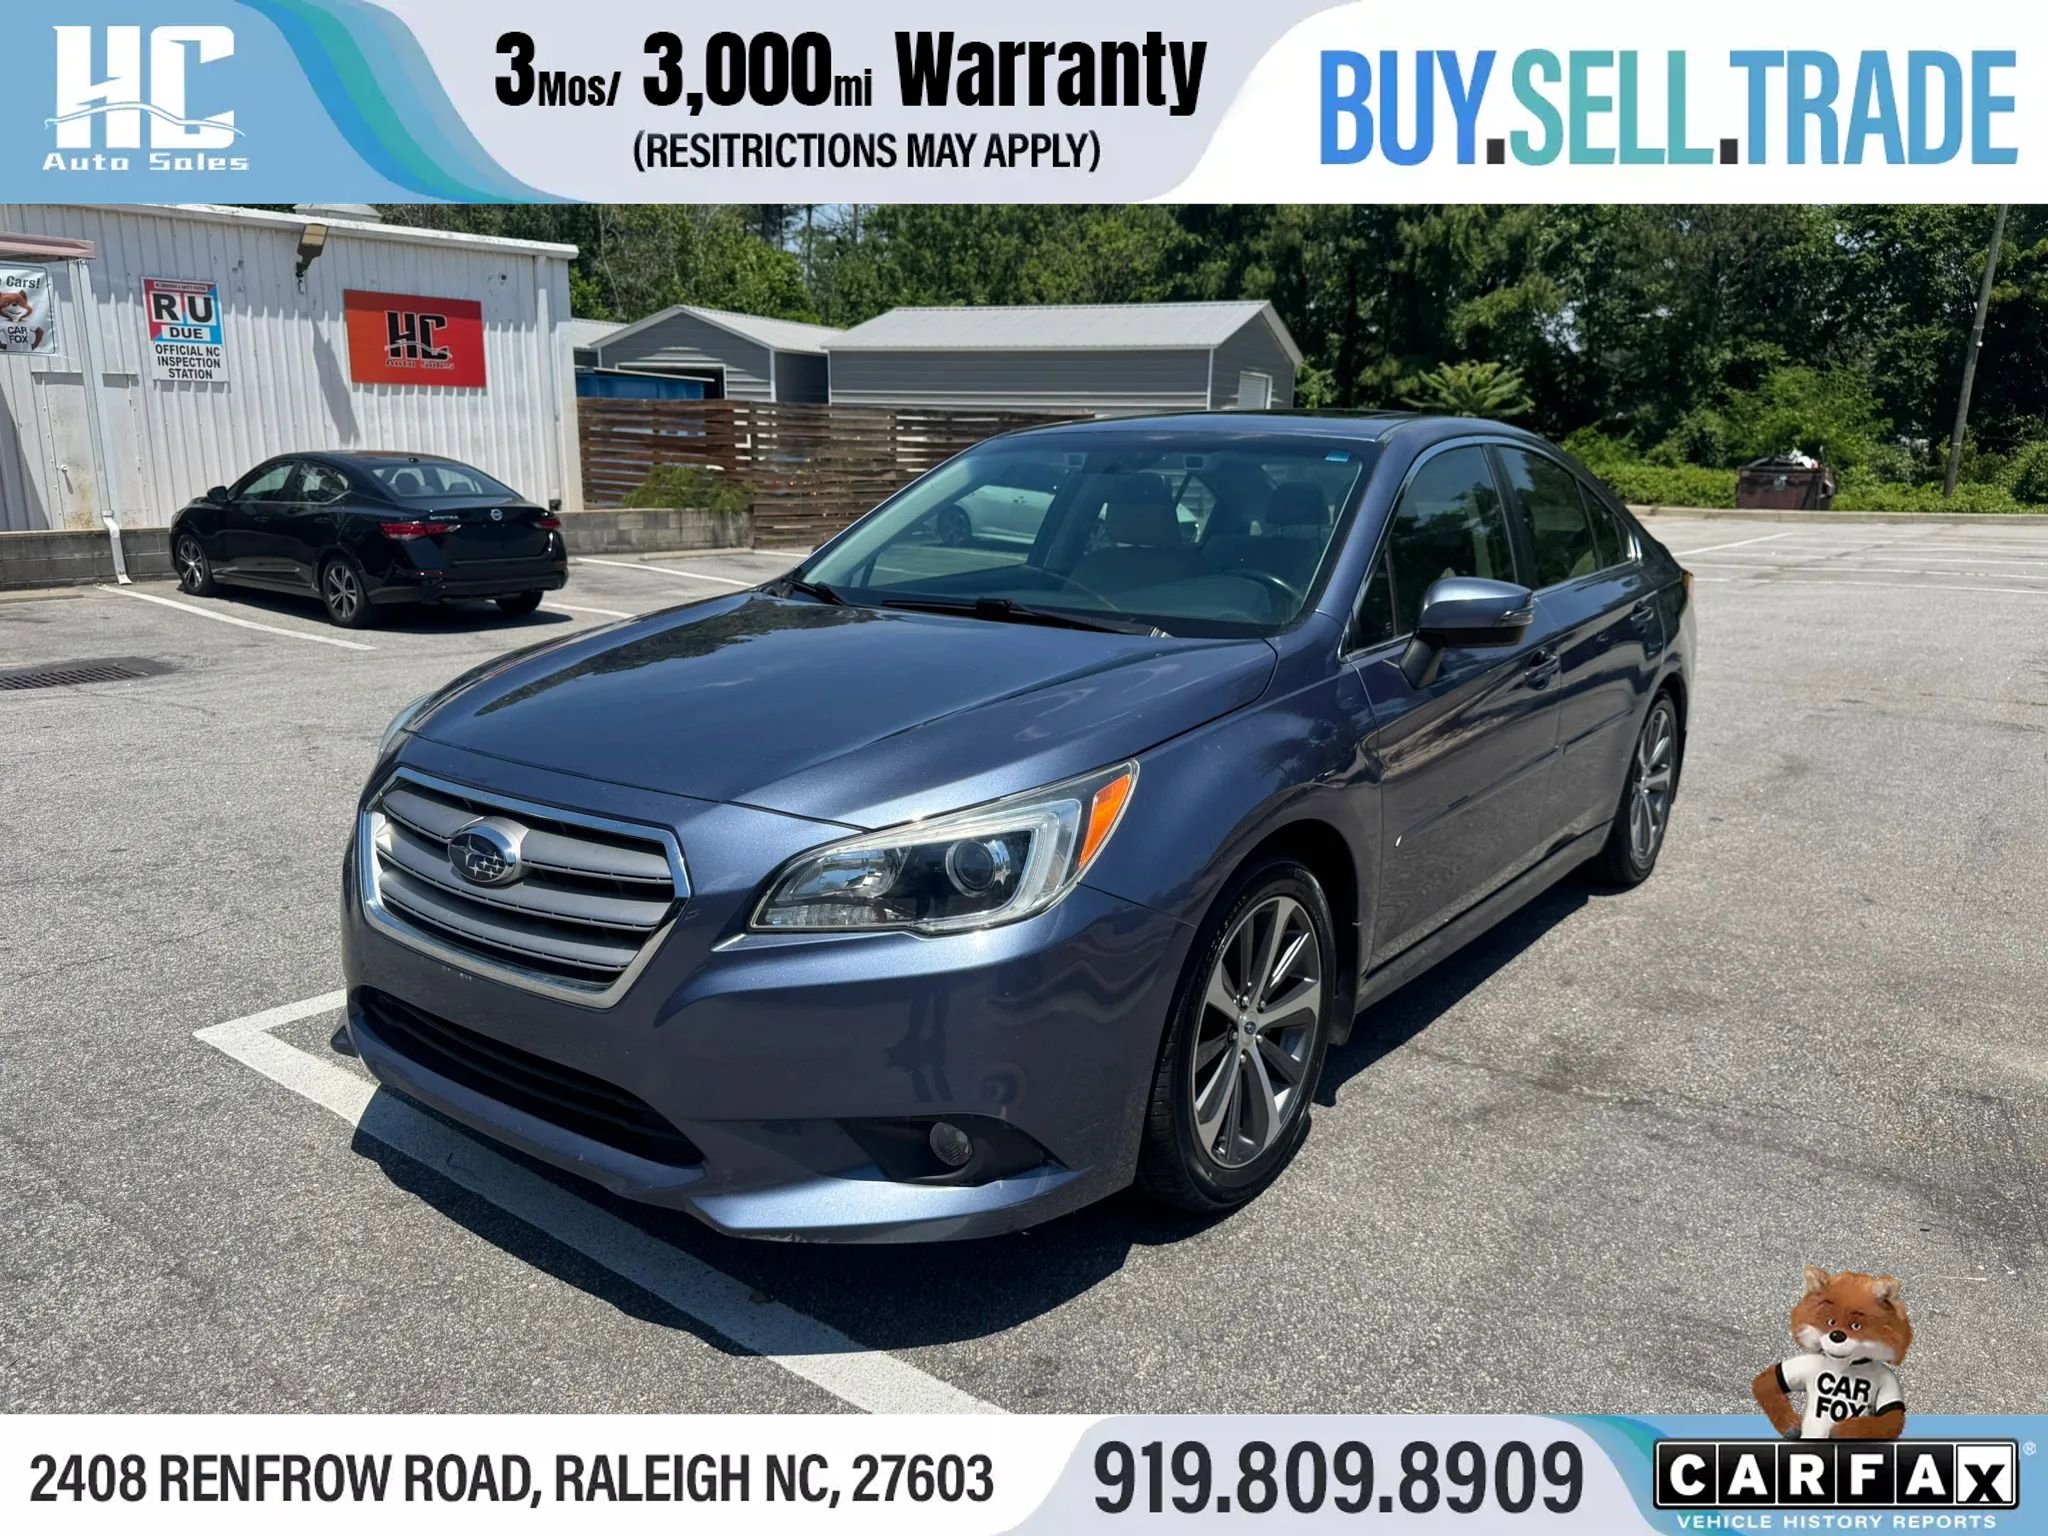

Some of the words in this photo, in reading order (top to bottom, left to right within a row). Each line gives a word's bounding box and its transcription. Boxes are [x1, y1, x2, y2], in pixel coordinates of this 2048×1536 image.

[6, 275, 41, 289] Cars!
[7, 326, 28, 335] CAR
[169, 327, 203, 339] DUE
[384, 310, 448, 362] HC
[9, 335, 29, 344] FOX
[155, 343, 204, 357] OFFICIAL
[206, 346, 221, 357] NC
[157, 355, 221, 369] INSPECTION
[168, 368, 213, 380] STATION
